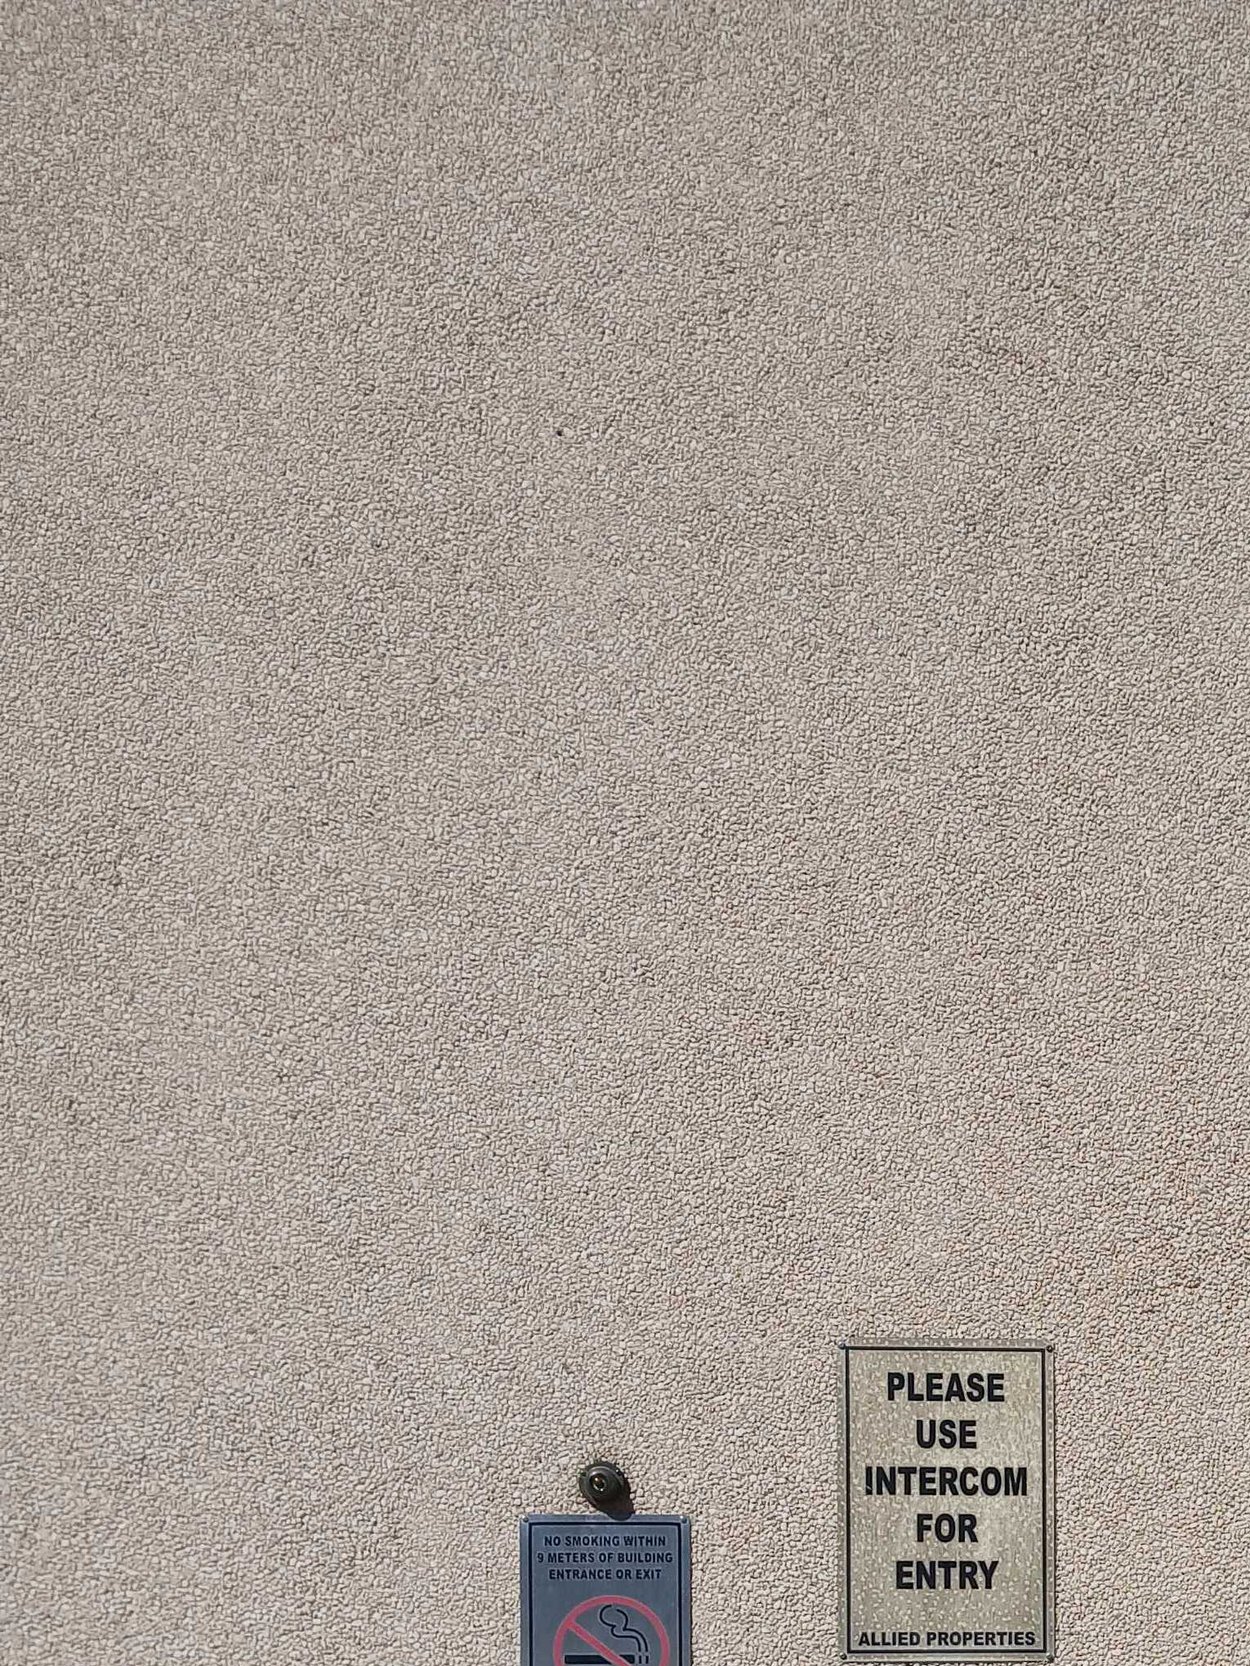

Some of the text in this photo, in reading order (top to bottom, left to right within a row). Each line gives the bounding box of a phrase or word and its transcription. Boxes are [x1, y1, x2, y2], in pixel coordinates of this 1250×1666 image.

[887, 1372, 1005, 1402] PLEASE
[916, 1419, 977, 1449] USE
[865, 1466, 1028, 1496] INTERCOM
[544, 1535, 666, 1547] NO SMOKING WITHIN
[916, 1513, 978, 1543] FOR
[537, 1552, 673, 1563] 9 METERS OF BUILDING
[548, 1569, 662, 1580] ENTRANCE OR EXIT
[895, 1560, 1000, 1590] ENTRY
[858, 1631, 1036, 1647] ALLIED PROPERTIES
